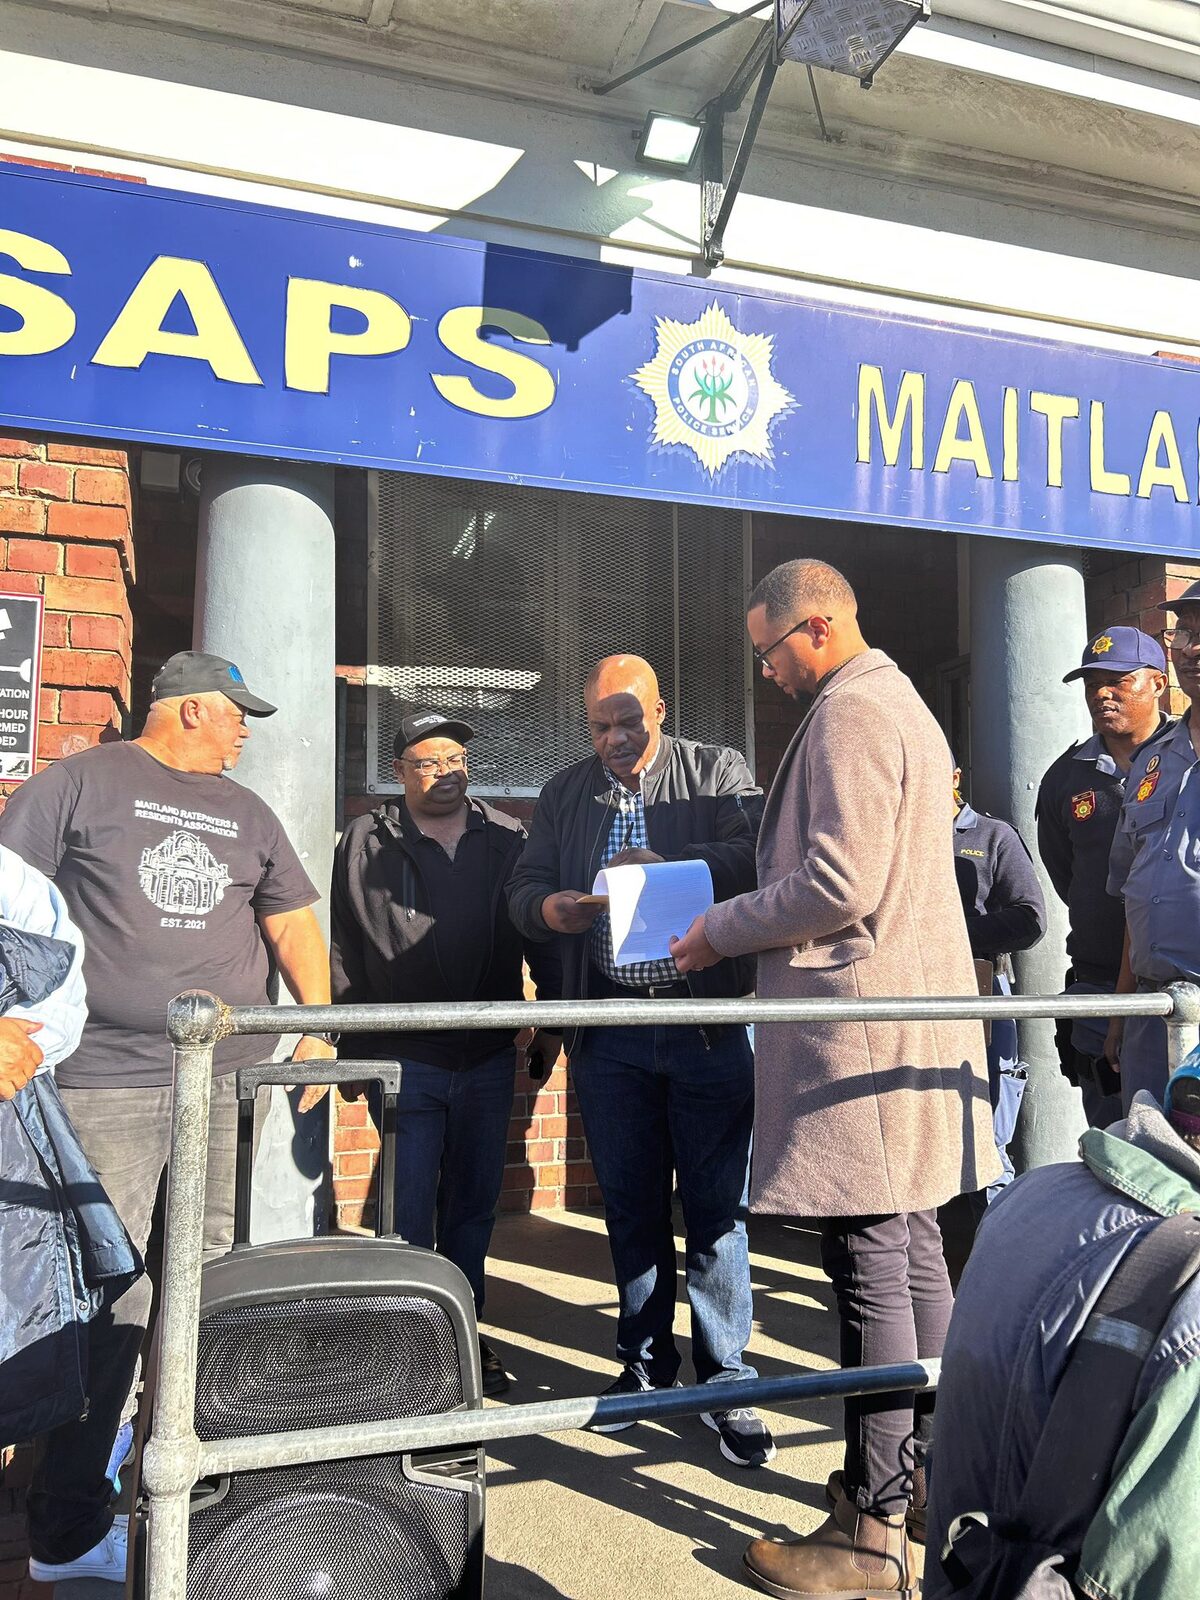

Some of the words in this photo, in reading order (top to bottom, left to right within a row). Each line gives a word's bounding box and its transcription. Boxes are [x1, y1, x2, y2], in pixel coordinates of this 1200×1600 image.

[0, 229, 558, 418] SAPS
[671, 341, 705, 376] SOUTH
[710, 341, 757, 387] AFRCAN
[672, 396, 707, 434] POLICE
[711, 407, 754, 436] SERICE
[856, 363, 1200, 506] MAITLA
[0, 687, 30, 699] ATION
[0, 722, 26, 733] MED
[0, 736, 17, 746] ED
[134, 799, 180, 816] MAITLAND
[180, 809, 232, 828] RATEPAYERS
[231, 821, 239, 831] &
[134, 809, 183, 826] RESIDENTS
[183, 820, 238, 838] ASSOCIATION
[160, 917, 183, 928] EST.
[183, 919, 206, 930] 2021
